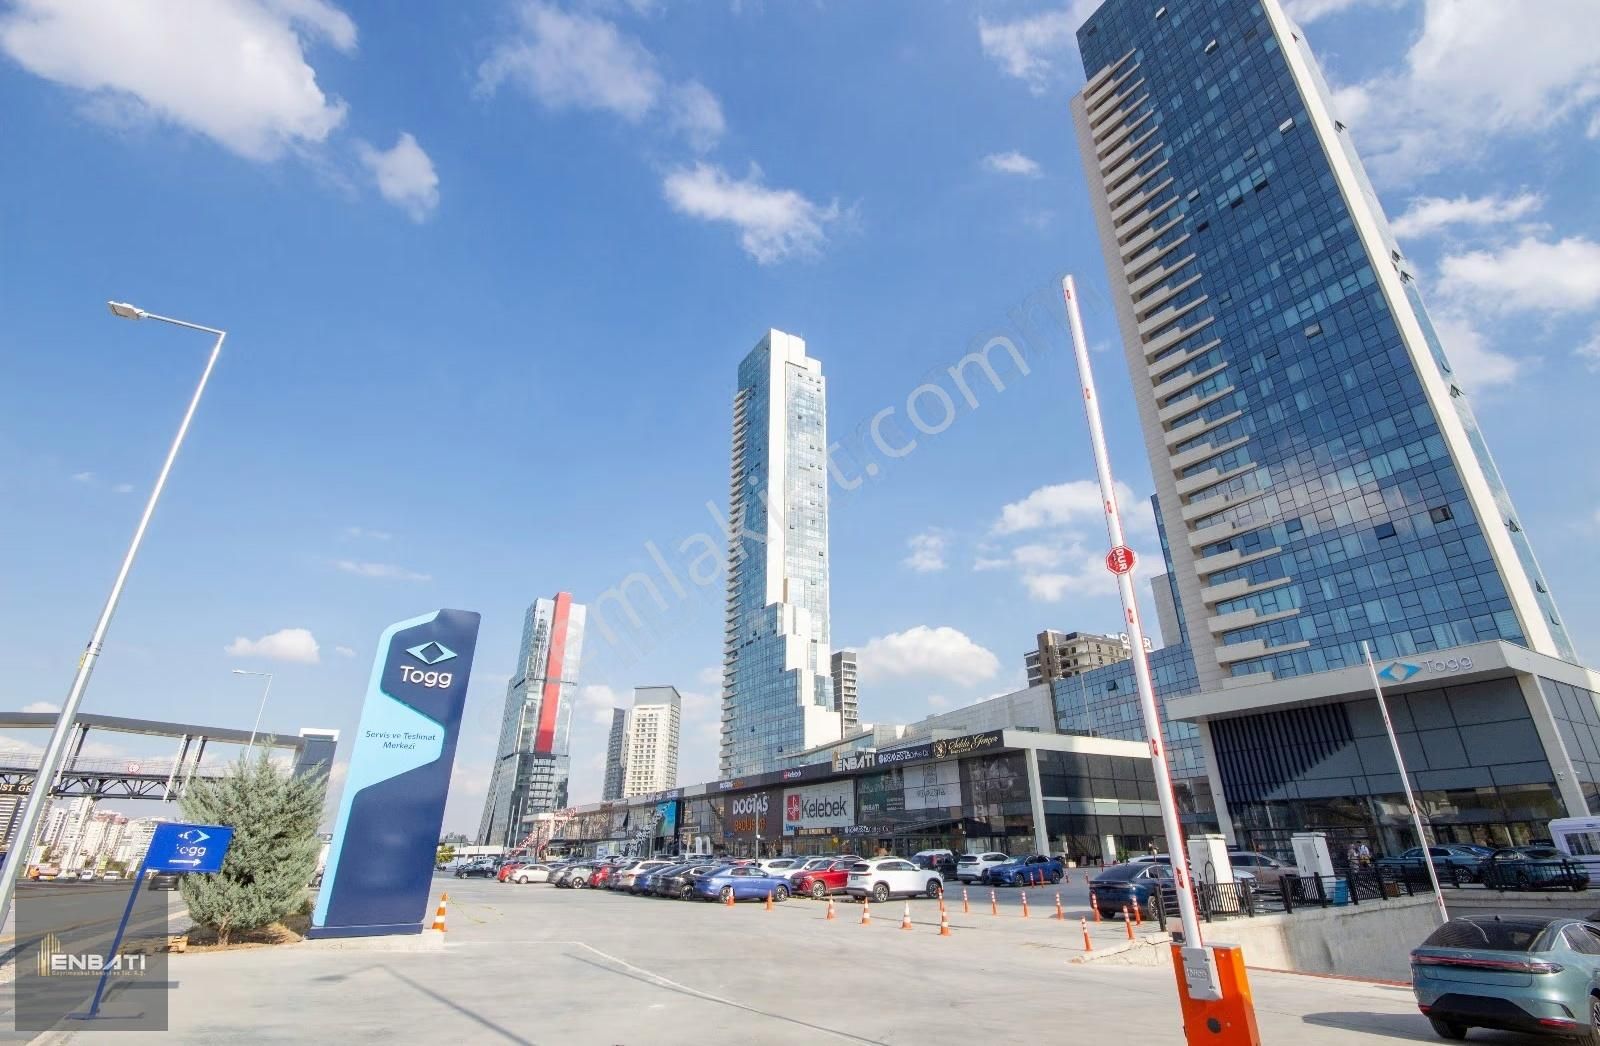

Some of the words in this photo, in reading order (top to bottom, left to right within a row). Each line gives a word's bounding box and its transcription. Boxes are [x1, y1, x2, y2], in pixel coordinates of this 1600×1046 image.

[1116, 548, 1128, 571] DUR
[1424, 655, 1473, 673] Togg
[400, 665, 452, 688] Togg
[365, 730, 390, 739] Servis
[383, 741, 415, 750] Merkezi
[837, 754, 876, 772] ENBATI
[801, 796, 847, 819] Kelebek
[176, 843, 206, 857] ogg
